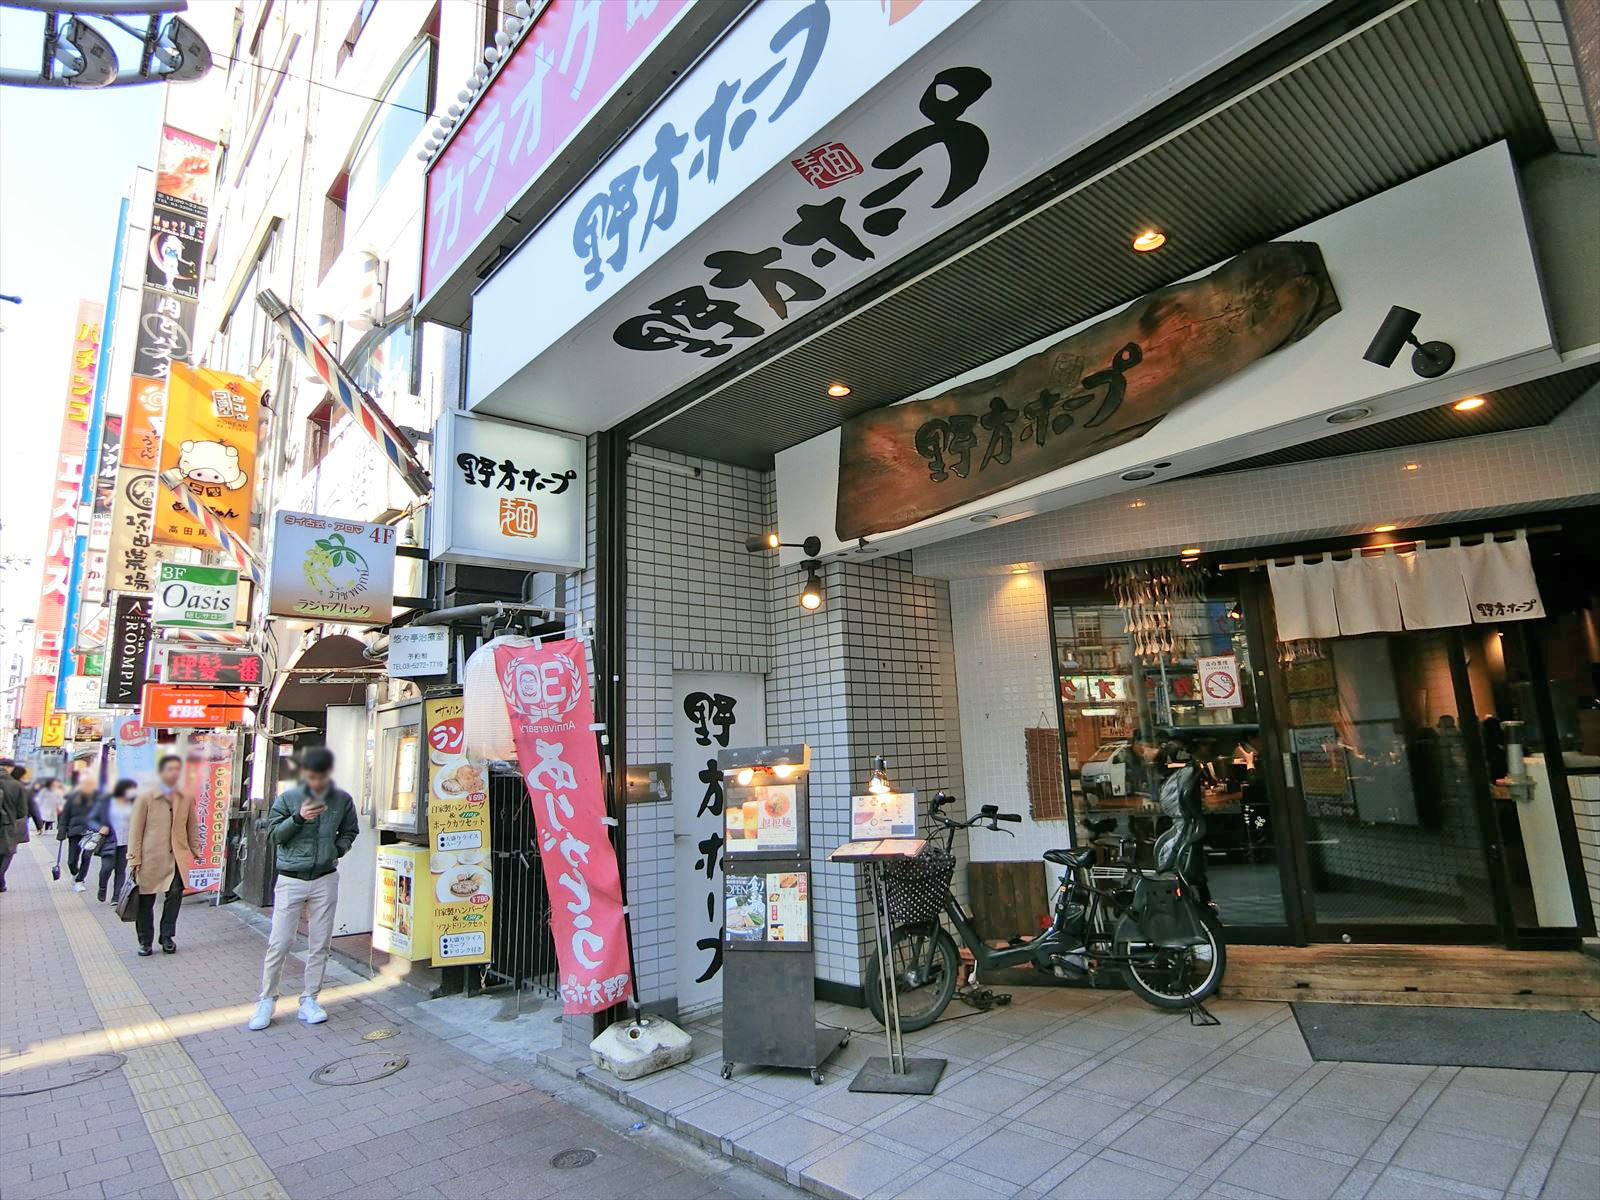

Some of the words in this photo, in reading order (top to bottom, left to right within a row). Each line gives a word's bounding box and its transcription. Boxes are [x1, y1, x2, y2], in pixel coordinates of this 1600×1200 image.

[612, 66, 993, 359] 野方ホープ
[195, 220, 206, 230] 3F
[67, 323, 98, 423] パチンコ
[914, 341, 1144, 483] 野方ホープ
[456, 452, 578, 495] 野方ホープ
[43, 456, 83, 596] エスパス
[283, 515, 365, 535] タイ古式・アロマ
[498, 497, 539, 539] 麺
[369, 527, 395, 545] 4F
[162, 566, 187, 580] 3F
[162, 583, 231, 611] Oasis
[297, 598, 371, 615] ラジャプルック
[1476, 598, 1537, 617] 野方ホープ
[119, 621, 139, 698] ROOMPIA
[170, 653, 259, 682] 理髪一番
[434, 703, 464, 718] ザ・ハン
[468, 793, 485, 802] ¥690
[431, 801, 486, 814] 自家製ハンバーグ
[434, 903, 489, 917] 自家製ハンバーグ
[436, 919, 488, 932] ソフトドリンクセット
